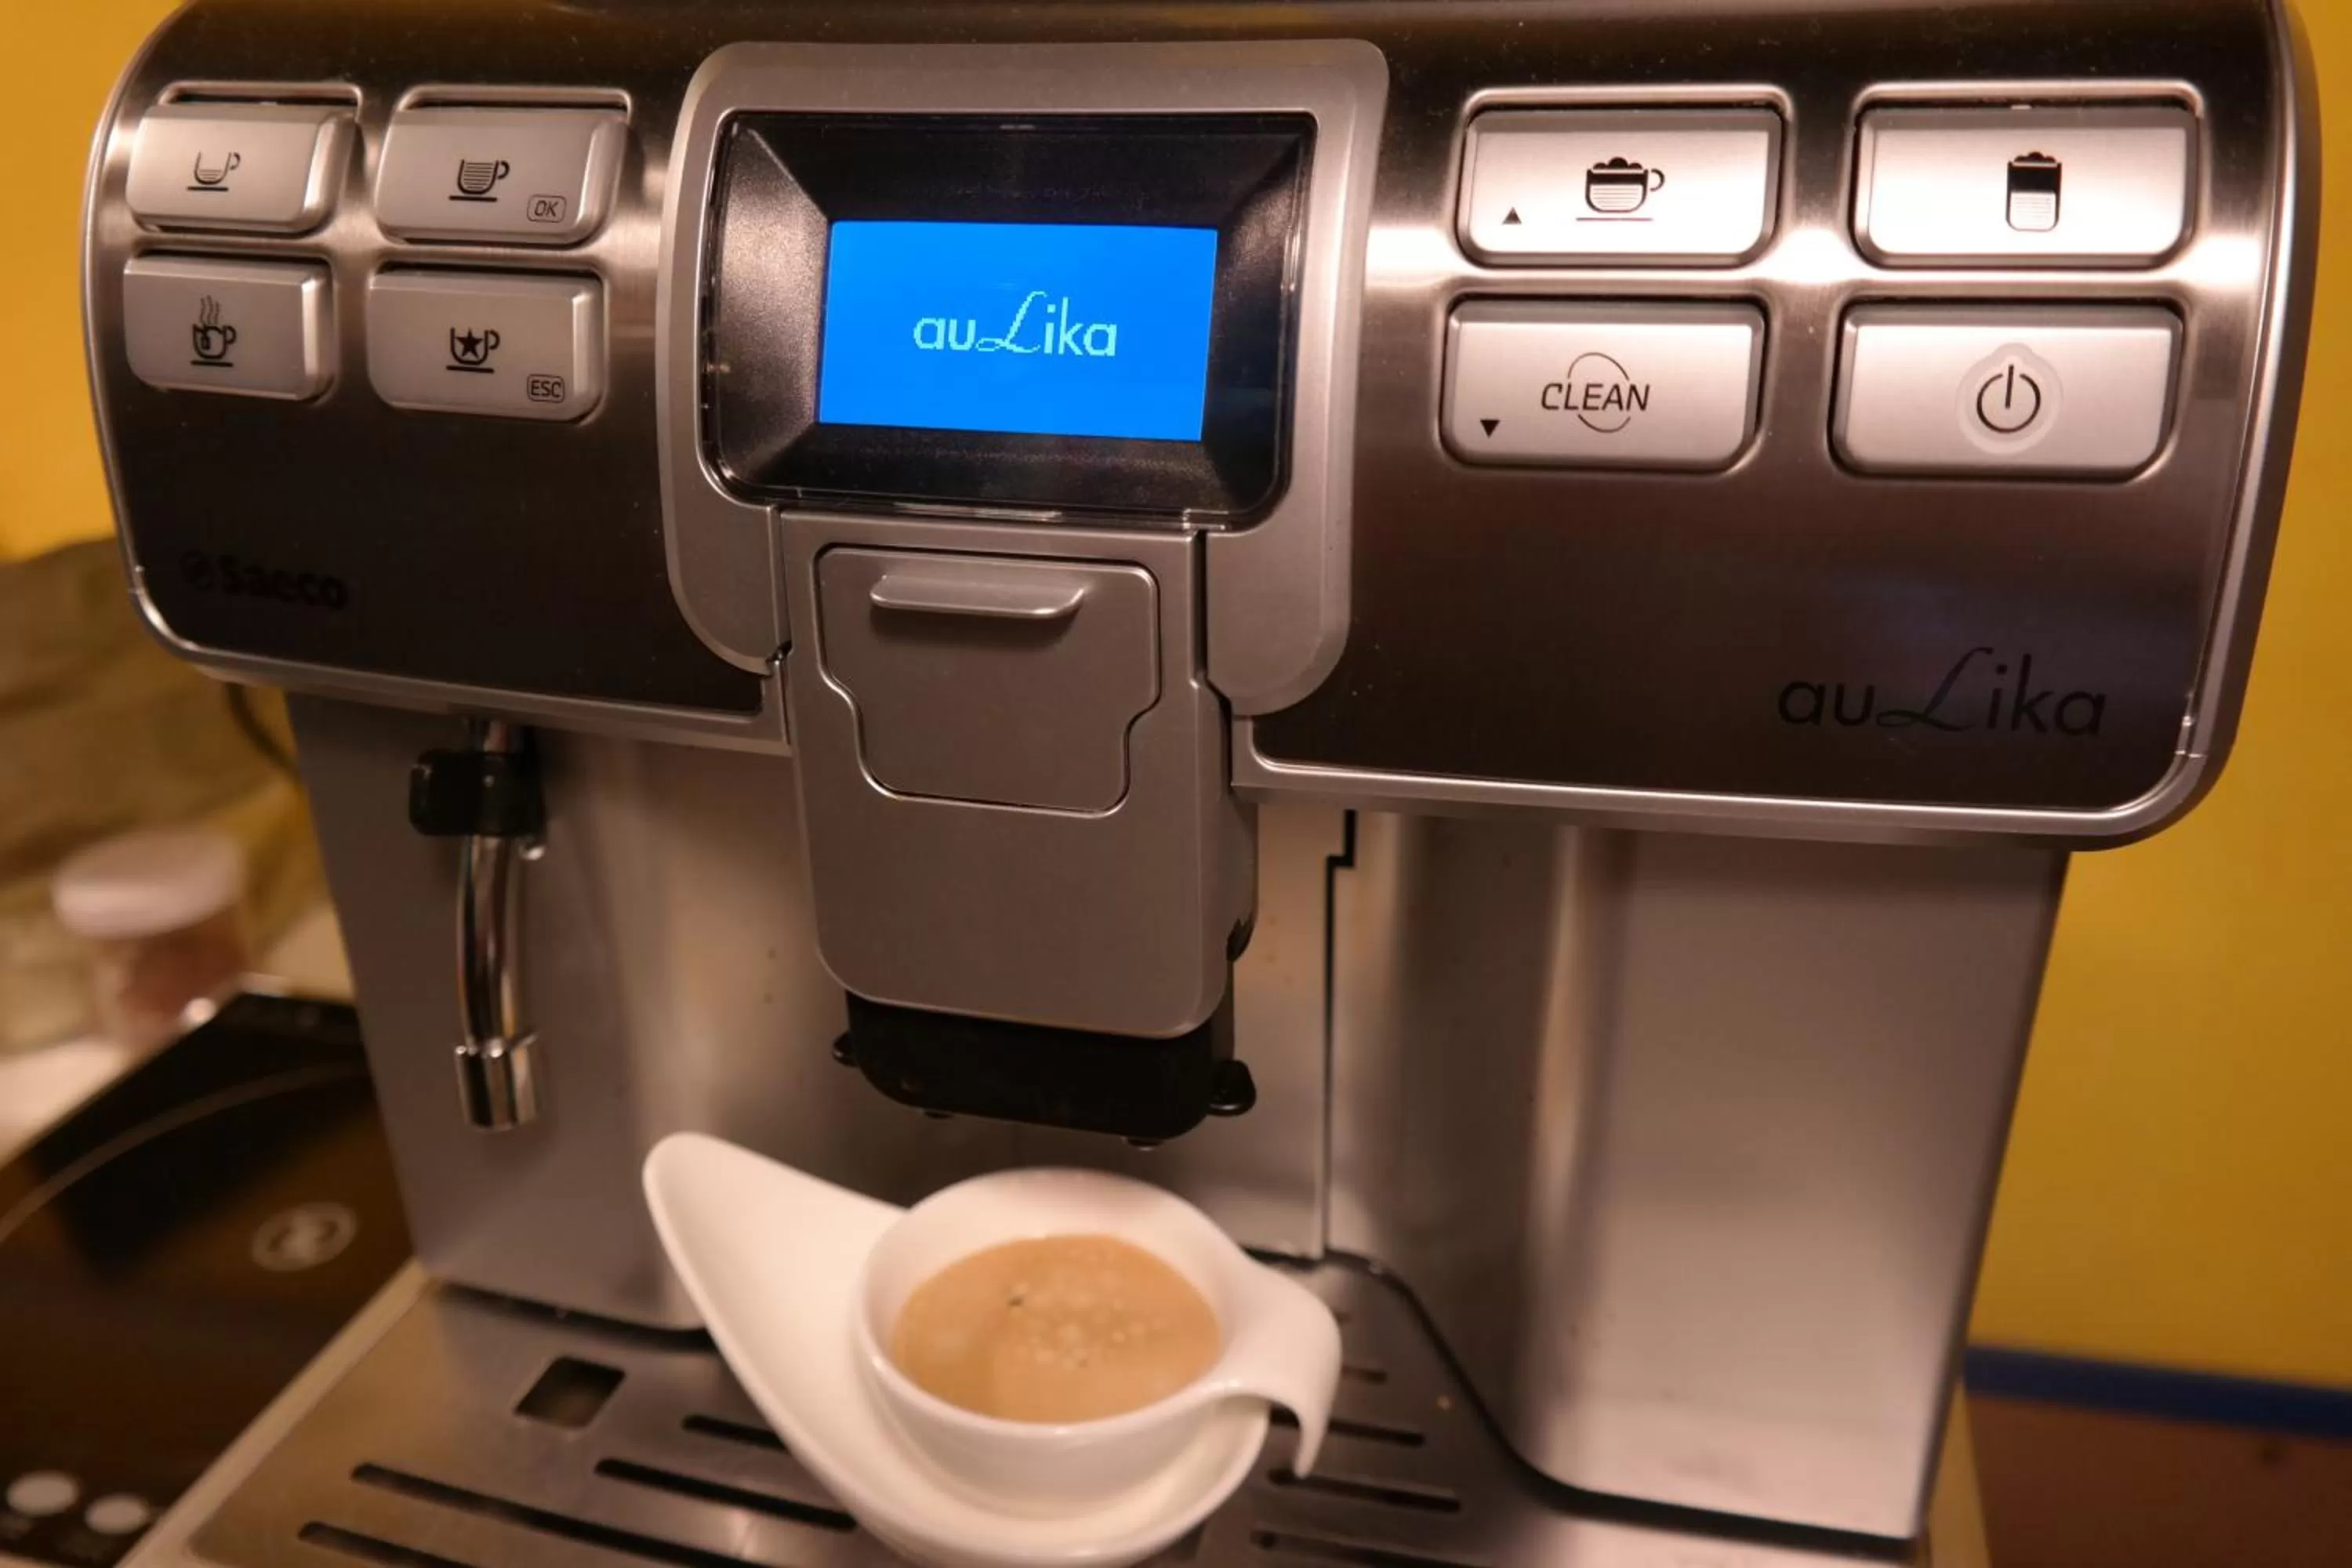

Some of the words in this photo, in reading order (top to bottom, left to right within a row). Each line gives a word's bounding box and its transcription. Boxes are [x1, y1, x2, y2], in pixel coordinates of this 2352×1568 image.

[534, 200, 559, 217] OK
[913, 291, 1117, 357] auLika
[531, 380, 561, 397] ESC
[1541, 382, 1650, 412] CLEAN
[218, 554, 348, 611] Saeco
[1777, 647, 2107, 735] auLika
